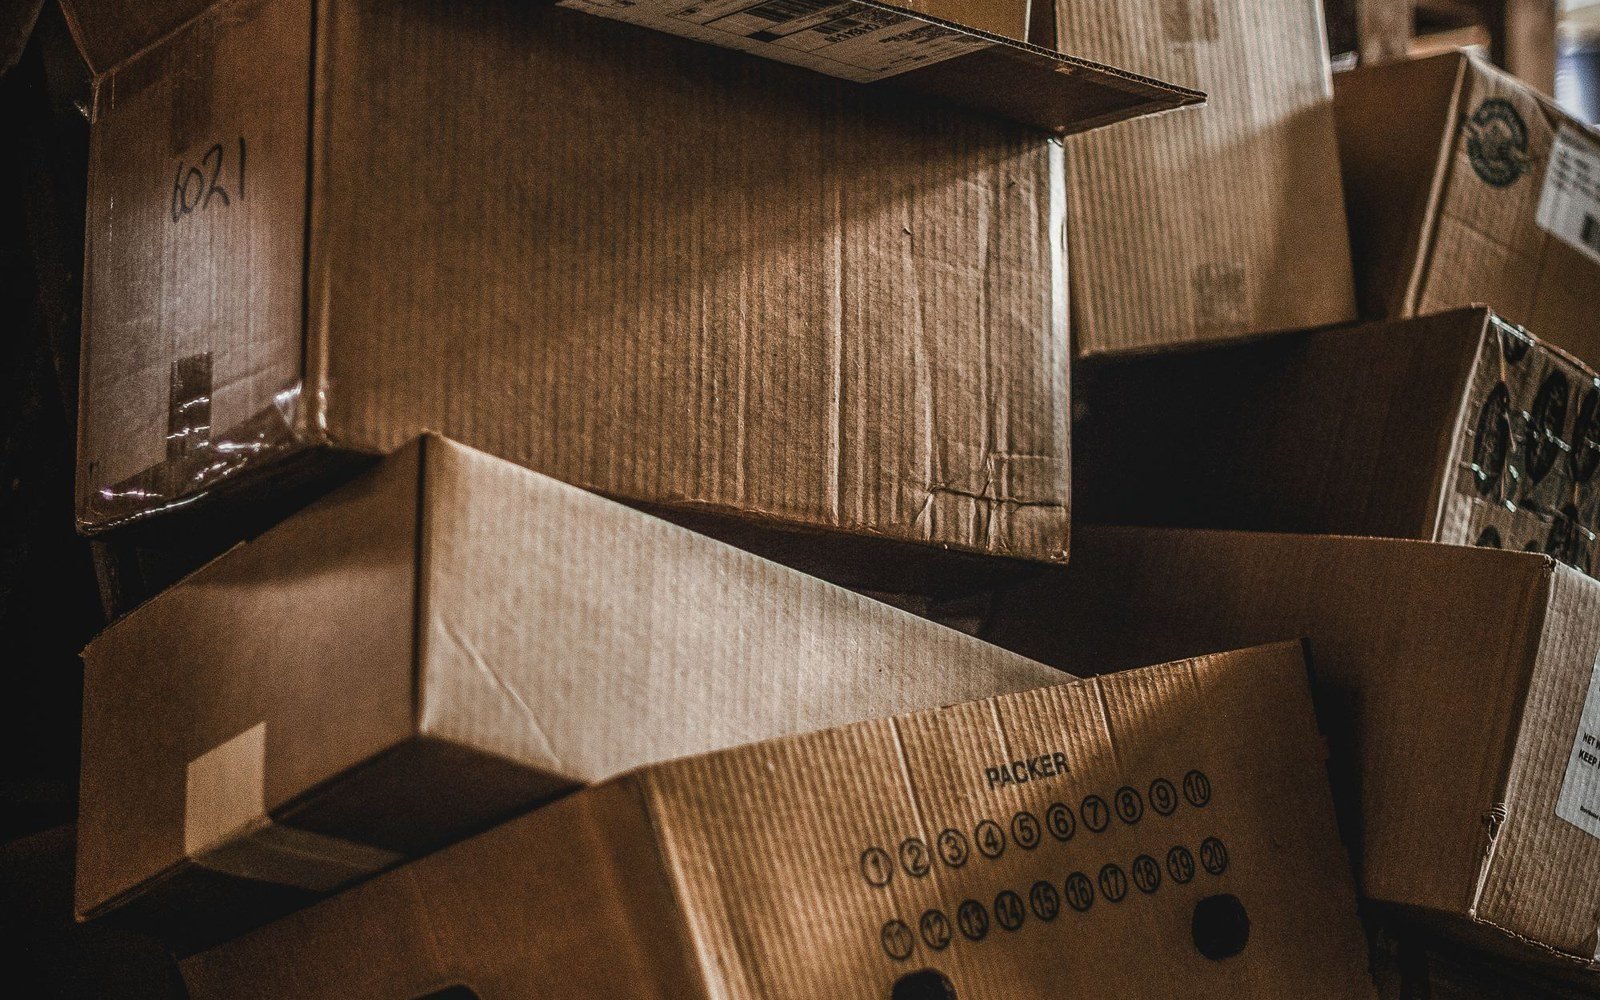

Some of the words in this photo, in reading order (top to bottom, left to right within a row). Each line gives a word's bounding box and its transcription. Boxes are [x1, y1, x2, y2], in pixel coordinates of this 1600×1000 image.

[1579, 749, 1597, 766] KEEP
[1583, 732, 1595, 746] NET
[985, 752, 1070, 790] PACKER
[868, 851, 889, 882] 1
[904, 842, 929, 873] 2
[942, 832, 963, 864] 3
[981, 823, 1002, 854] 4
[1016, 815, 1036, 845] 5
[1051, 806, 1071, 836] 6
[1082, 797, 1102, 829] 7
[1119, 790, 1139, 820] 8
[1153, 782, 1173, 812] 9
[1185, 773, 1208, 803] 10
[923, 913, 948, 948] 12
[960, 903, 986, 938] 13
[998, 893, 1022, 928] 14
[1034, 885, 1057, 919] 15
[1069, 875, 1092, 909] 16
[1102, 867, 1122, 899] 17
[1136, 859, 1158, 892] 18
[1170, 849, 1193, 881] 19
[1203, 840, 1225, 873] 20
